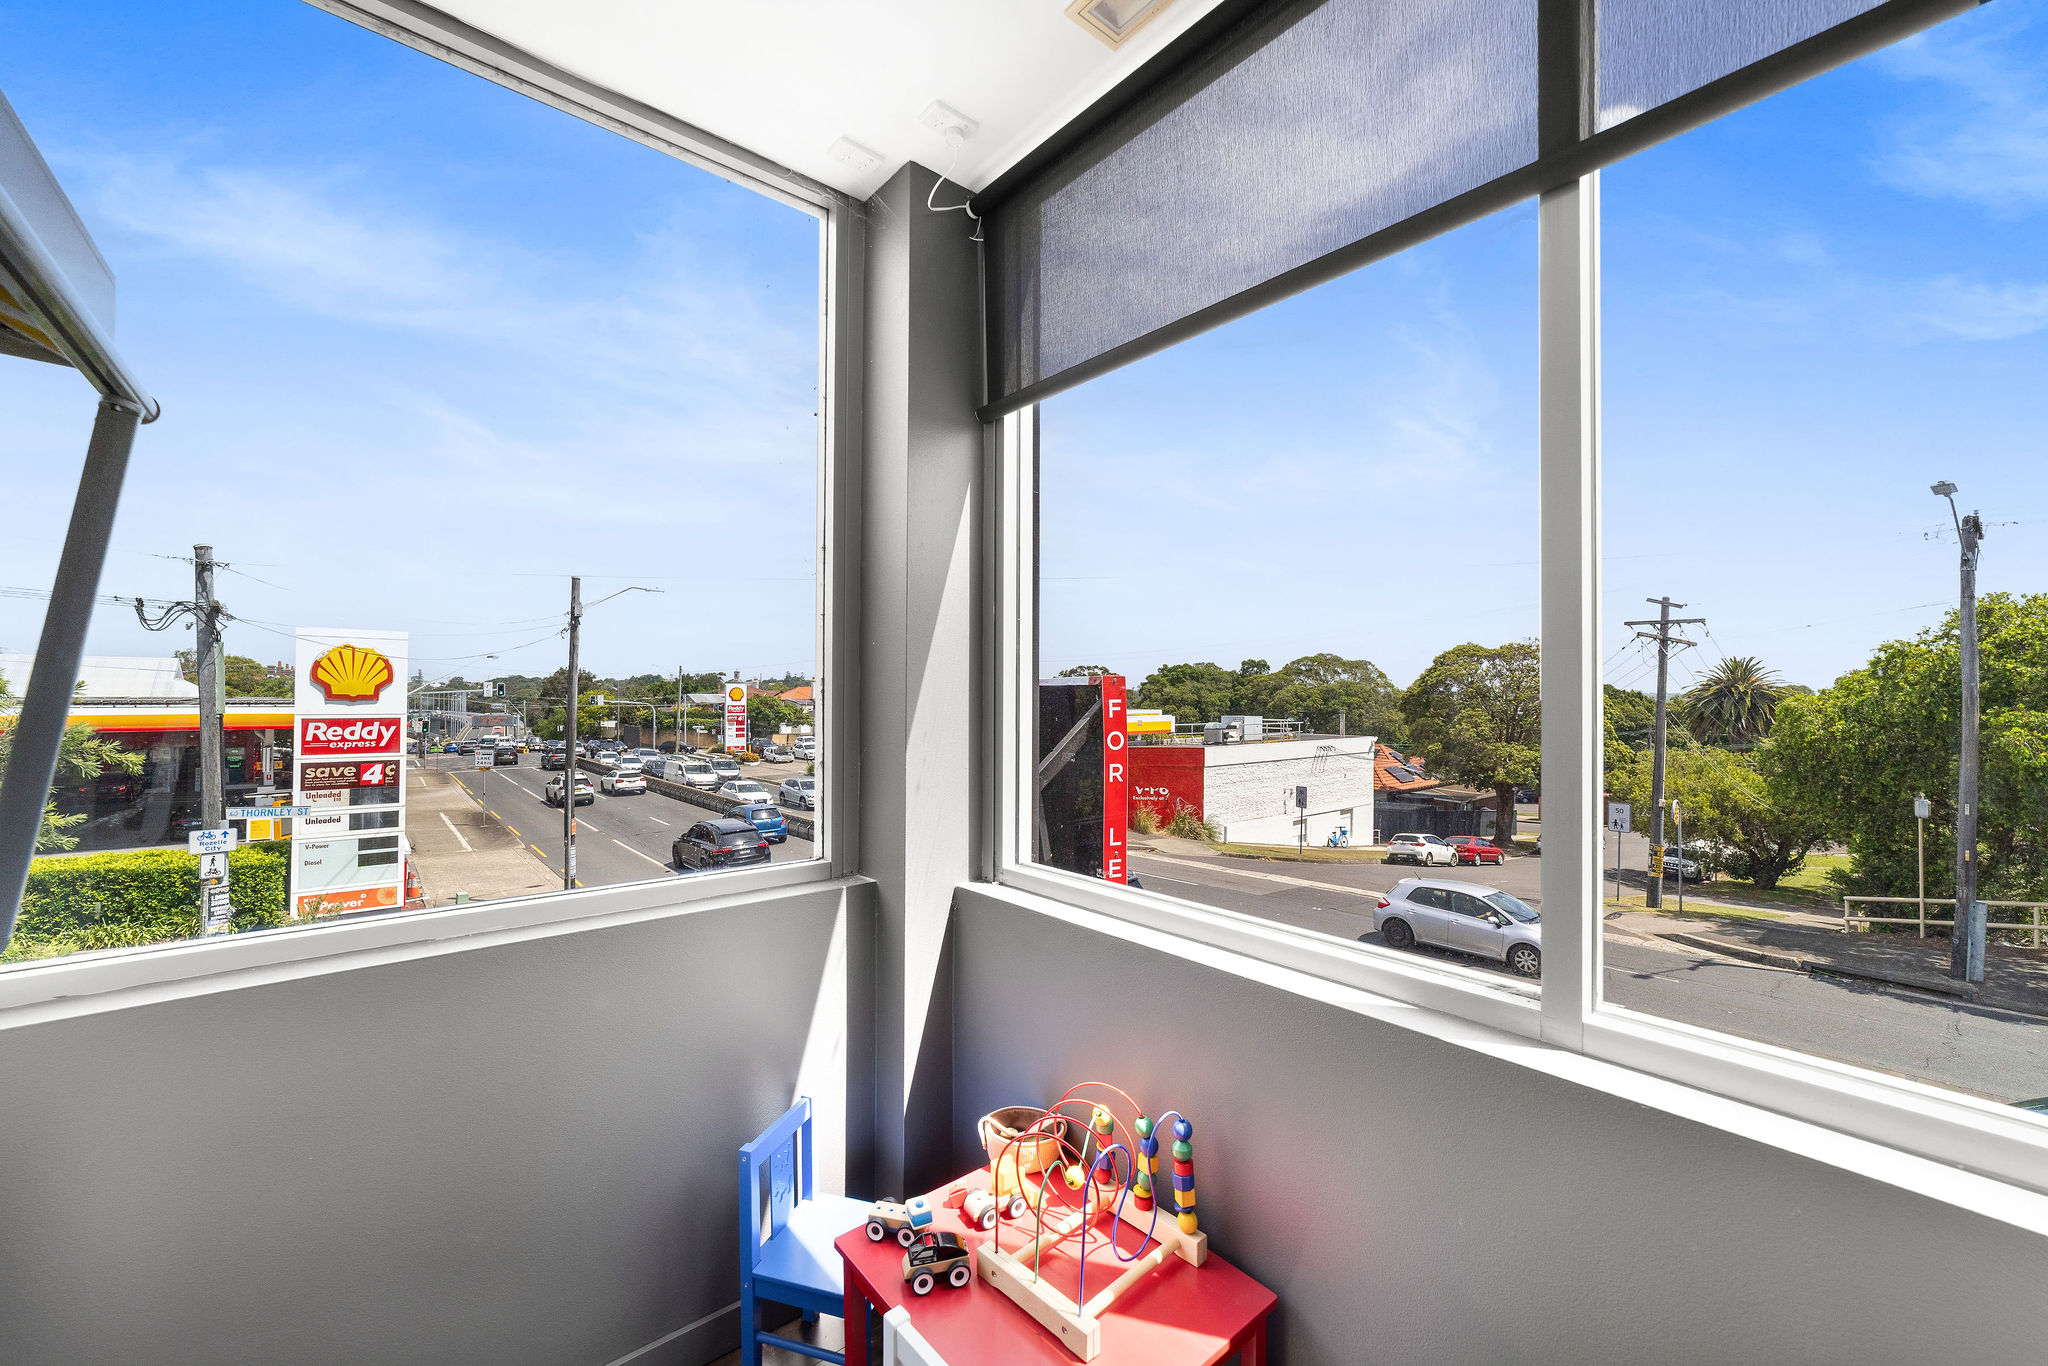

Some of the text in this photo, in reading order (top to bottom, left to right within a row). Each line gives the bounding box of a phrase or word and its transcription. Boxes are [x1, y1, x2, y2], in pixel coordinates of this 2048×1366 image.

[305, 721, 398, 747] Reddy
[329, 741, 376, 750] express
[1106, 699, 1125, 784] FOR
[304, 766, 357, 778] save
[305, 790, 342, 800] Unleaded
[240, 807, 292, 818] THORNLEY
[297, 807, 309, 816] ST
[1615, 807, 1625, 815] 50
[305, 816, 341, 825] Unleaded
